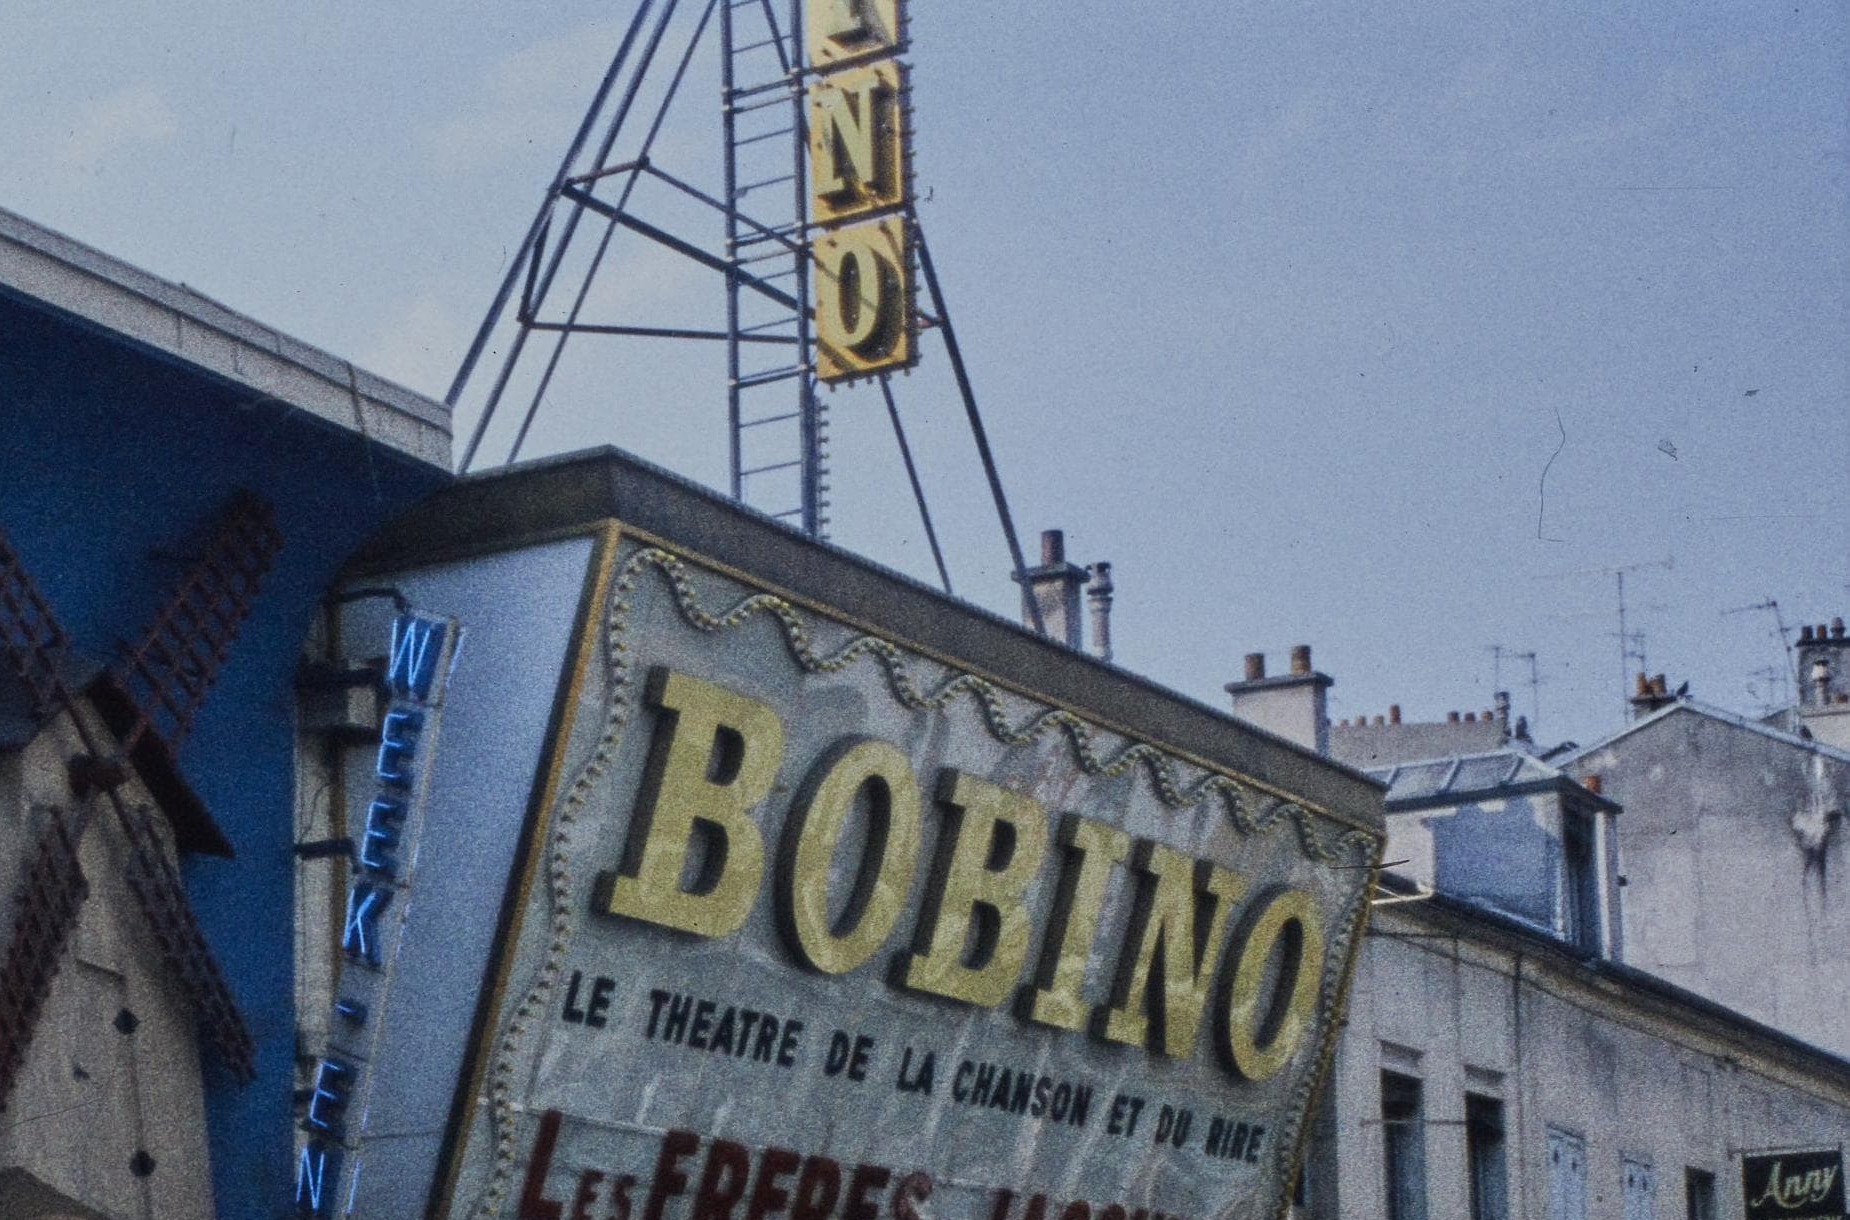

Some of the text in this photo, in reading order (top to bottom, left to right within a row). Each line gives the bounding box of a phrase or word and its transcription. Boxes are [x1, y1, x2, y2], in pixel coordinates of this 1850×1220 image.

[598, 668, 1326, 1084] BOBINO
[561, 971, 1268, 1164] LE THEATRE DE LA CHANSON ET DU RIRE
